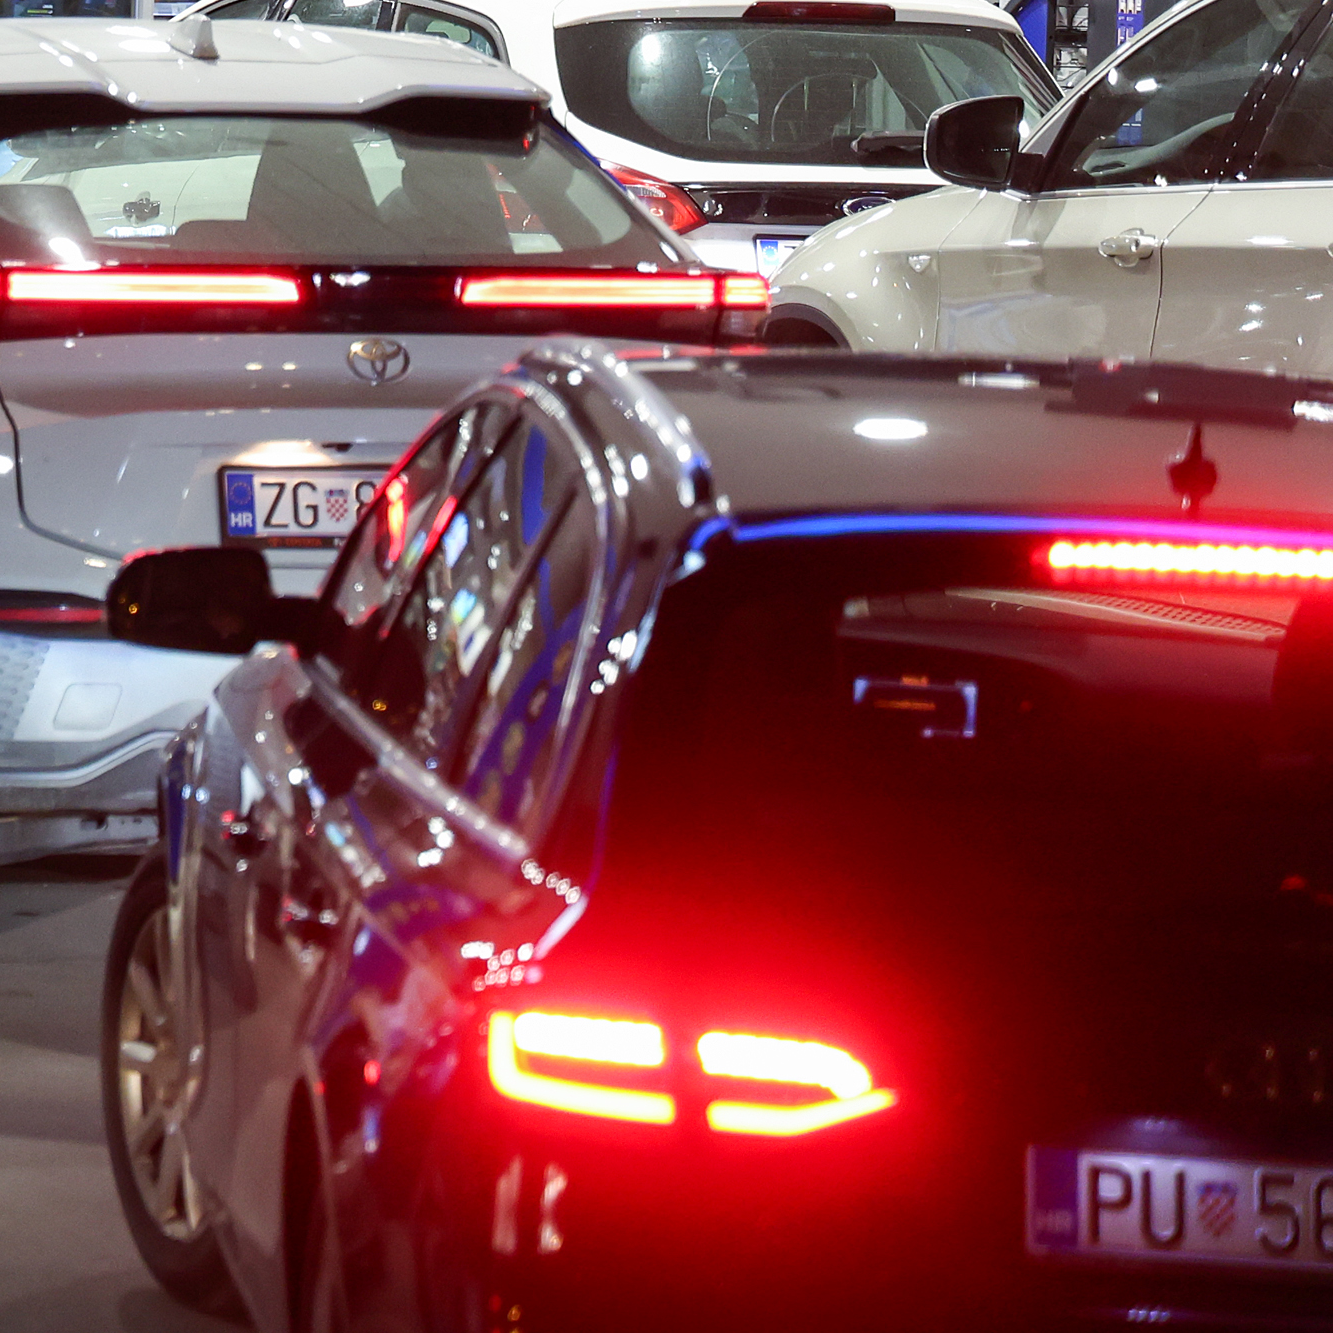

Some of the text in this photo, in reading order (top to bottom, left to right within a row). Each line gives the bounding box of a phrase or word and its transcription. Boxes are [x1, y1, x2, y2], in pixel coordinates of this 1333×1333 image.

[230, 512, 253, 528] HR
[260, 480, 319, 529] ZG
[1086, 1164, 1186, 1250] PU
